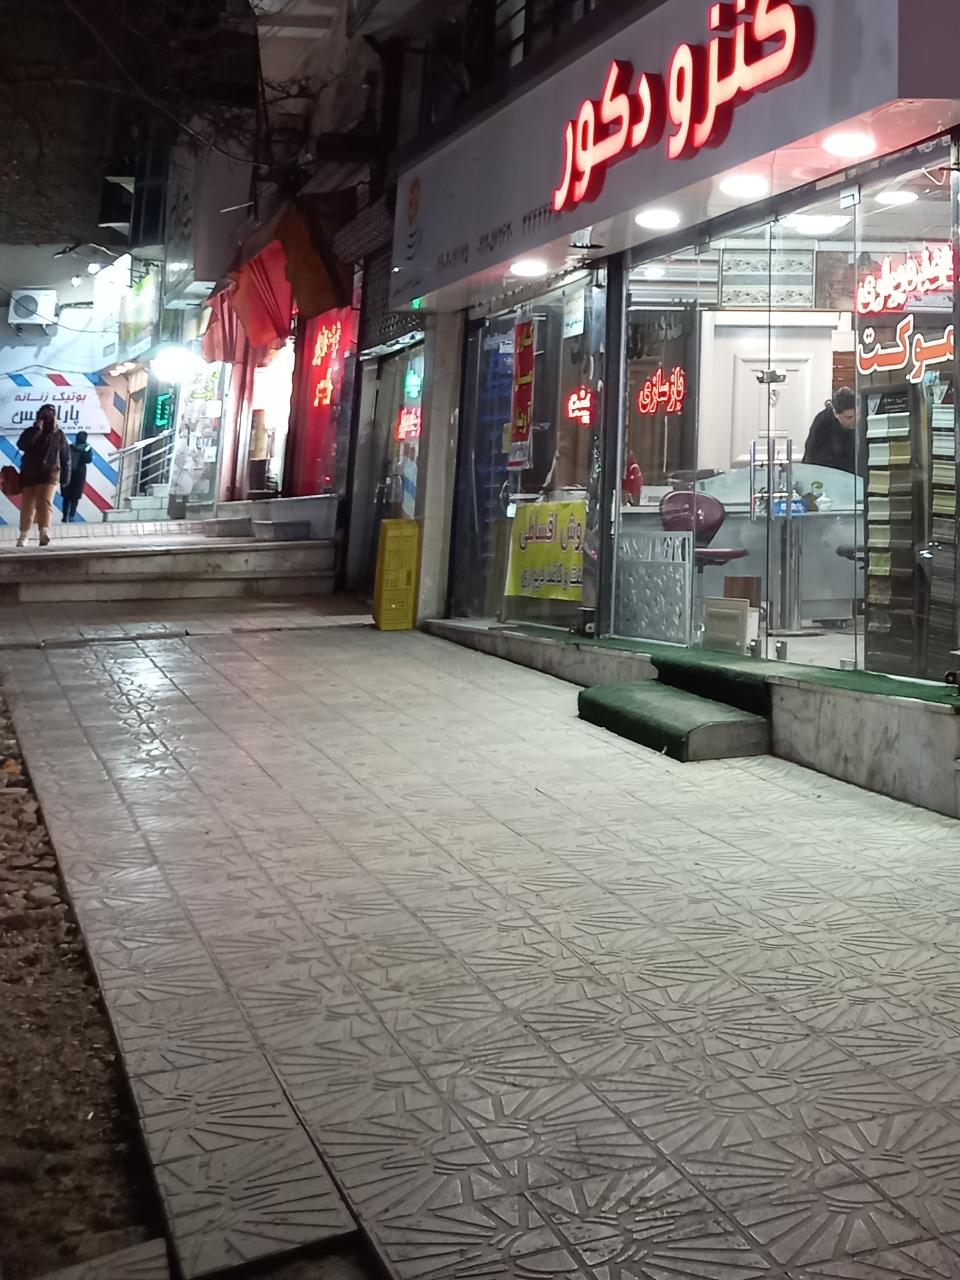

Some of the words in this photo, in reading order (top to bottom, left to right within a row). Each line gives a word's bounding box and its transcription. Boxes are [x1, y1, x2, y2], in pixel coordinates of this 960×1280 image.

[552, 59, 664, 212] دکور
[14, 392, 49, 403] زنانه
[52, 392, 87, 403] بوتیک
